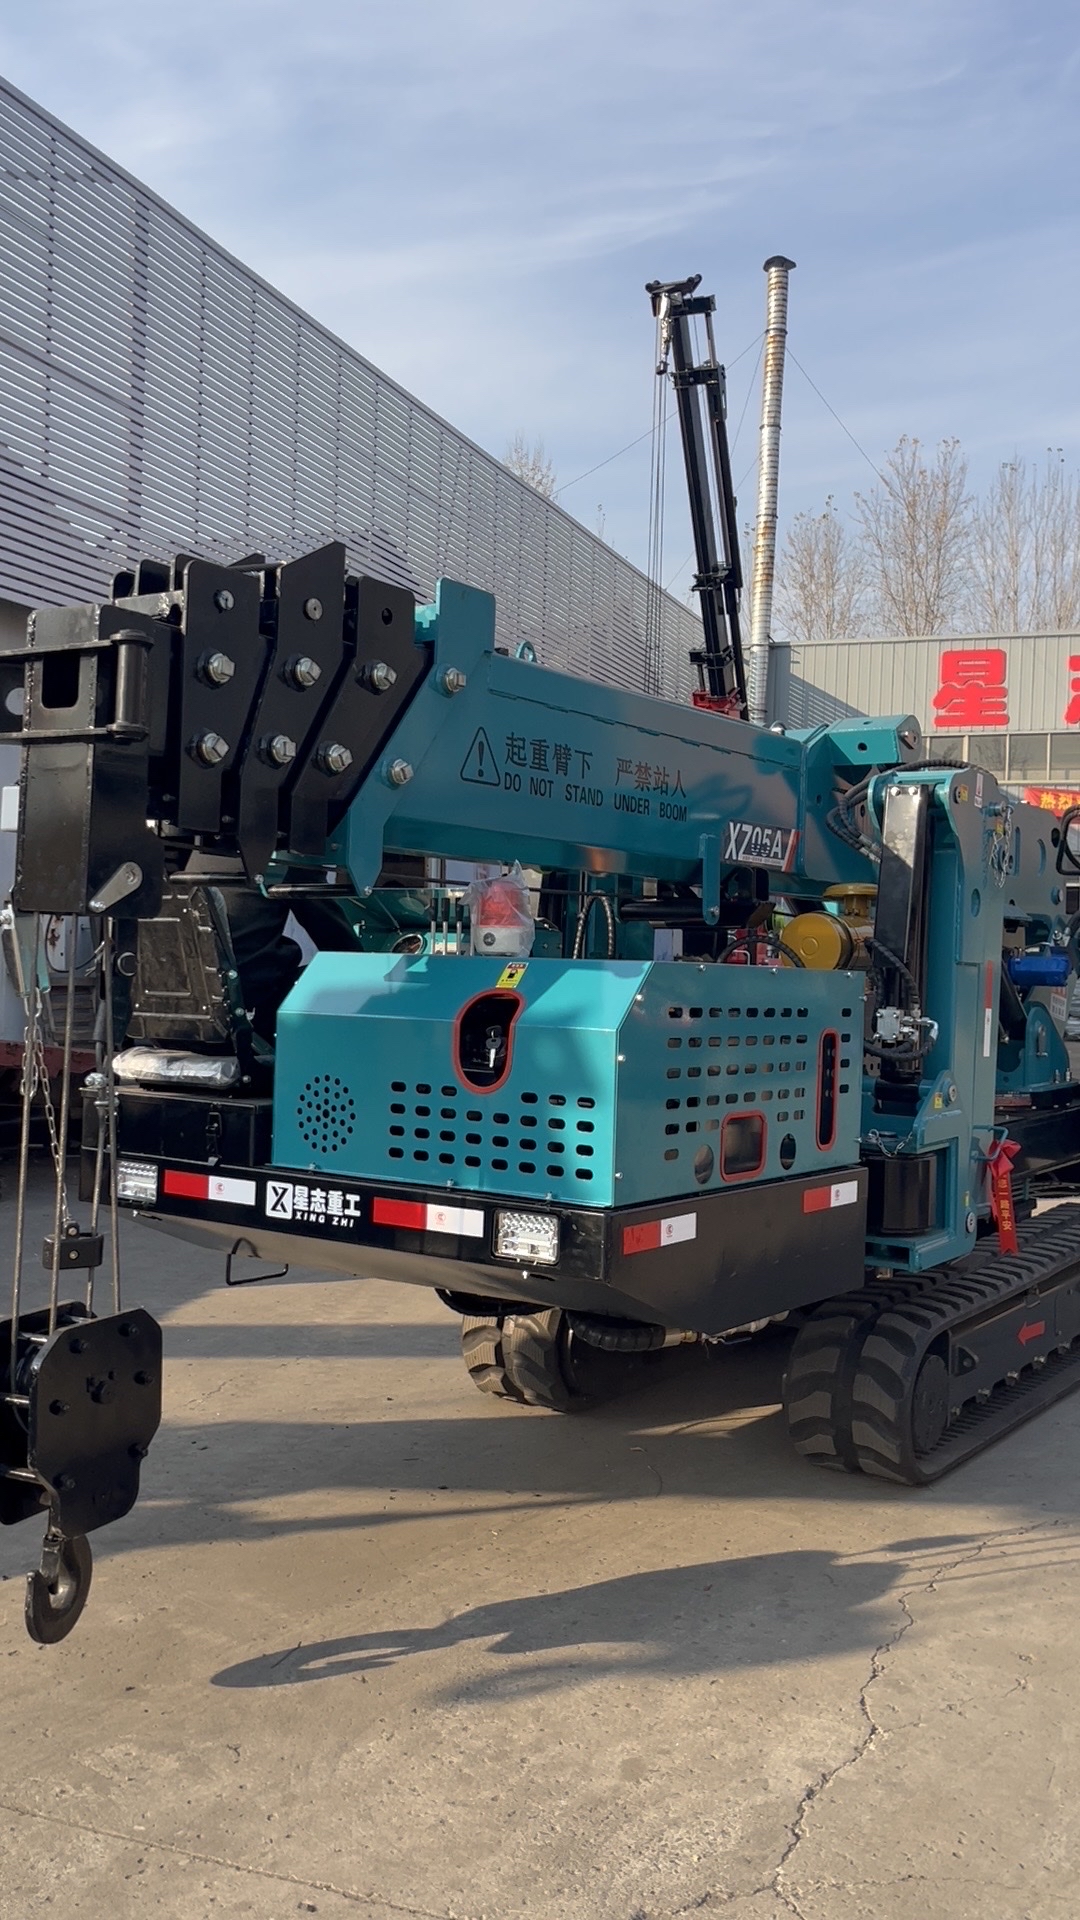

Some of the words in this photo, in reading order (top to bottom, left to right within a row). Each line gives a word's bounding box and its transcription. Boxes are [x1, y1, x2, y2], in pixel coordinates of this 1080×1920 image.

[505, 731, 594, 779] 起重臂下
[615, 757, 687, 799] 严禁站人
[504, 772, 522, 792] DO
[530, 776, 554, 798] NOT
[565, 784, 604, 807] STAND
[614, 792, 650, 816] UNDER
[659, 801, 687, 822] BOOM
[724, 821, 783, 861] XZ05A
[293, 1184, 361, 1217] 星志重工
[295, 1210, 325, 1224] XING
[332, 1216, 354, 1228] ZHI
